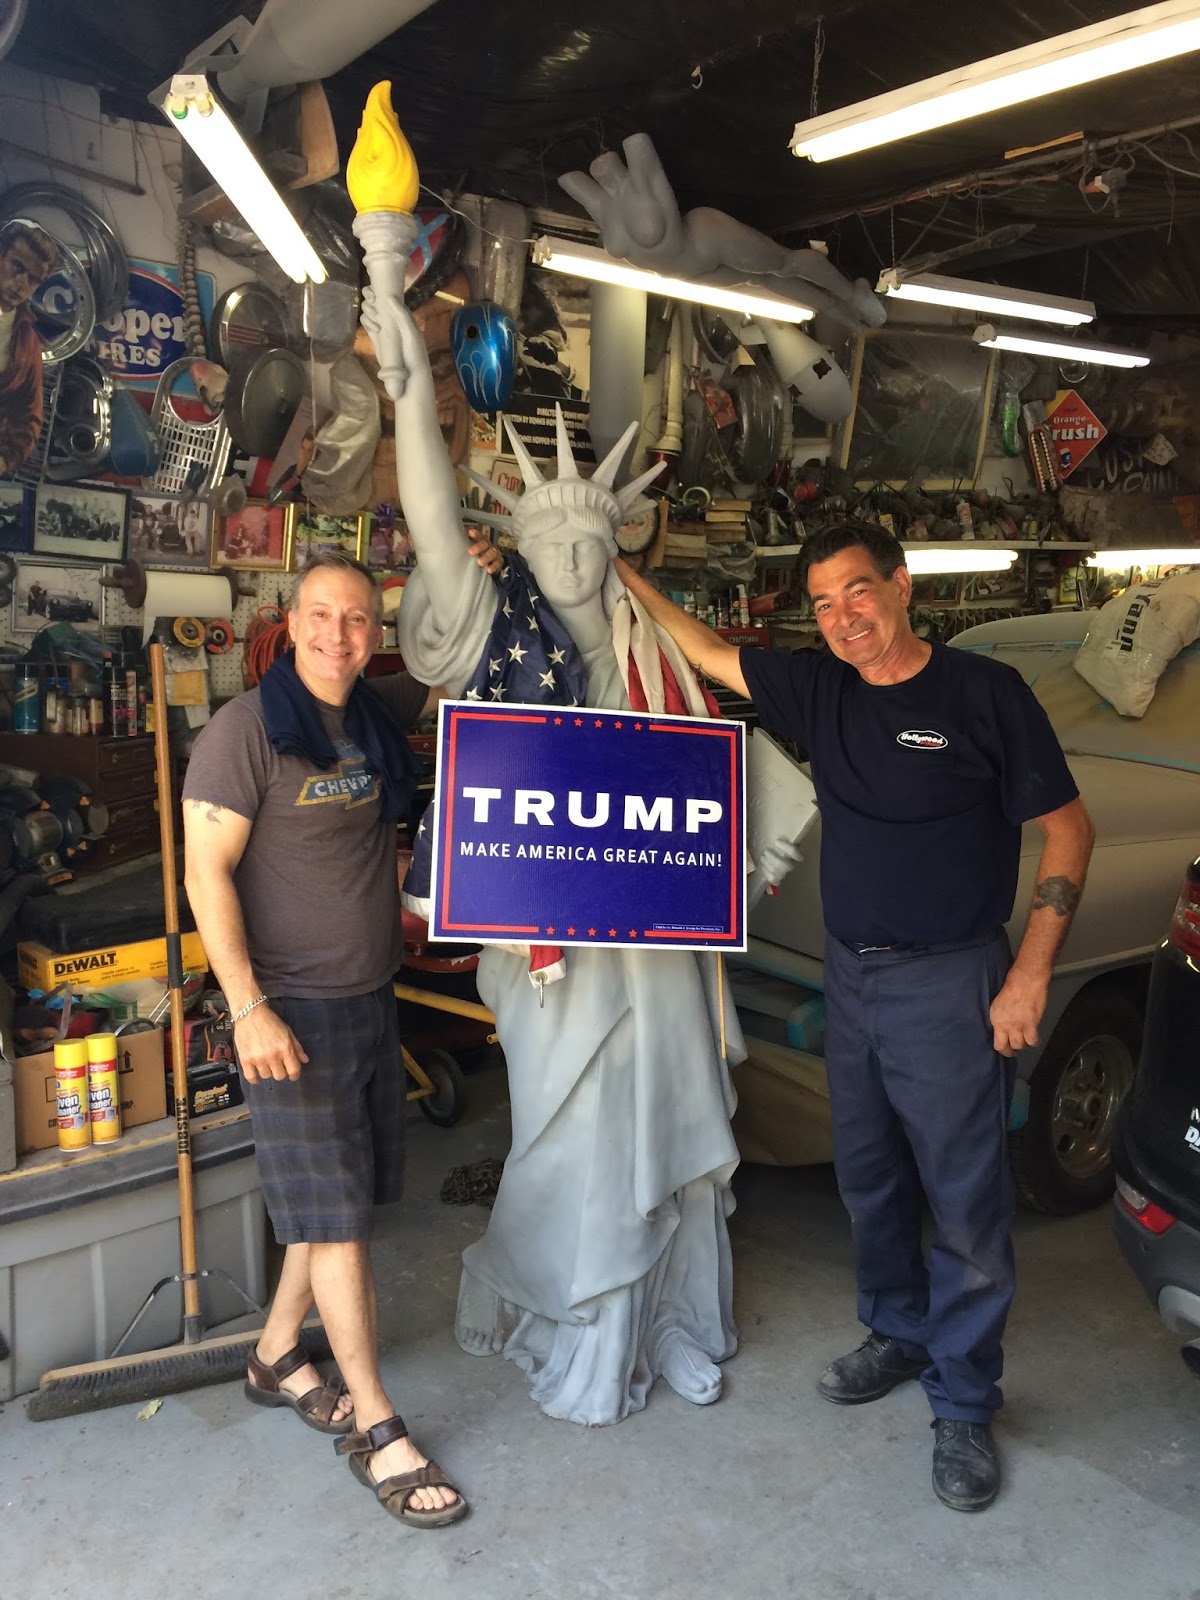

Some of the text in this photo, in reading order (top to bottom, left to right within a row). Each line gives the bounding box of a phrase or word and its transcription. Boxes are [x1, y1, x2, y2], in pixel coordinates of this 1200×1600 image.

[1051, 423, 1100, 441] rush
[462, 786, 723, 834] TRUMP
[460, 841, 722, 867] MAKE AMERICA GREAT AGAIN!
[91, 1088, 110, 1101] ven
[91, 1099, 111, 1111] eaner
[176, 1097, 190, 1155] JOBSITE
